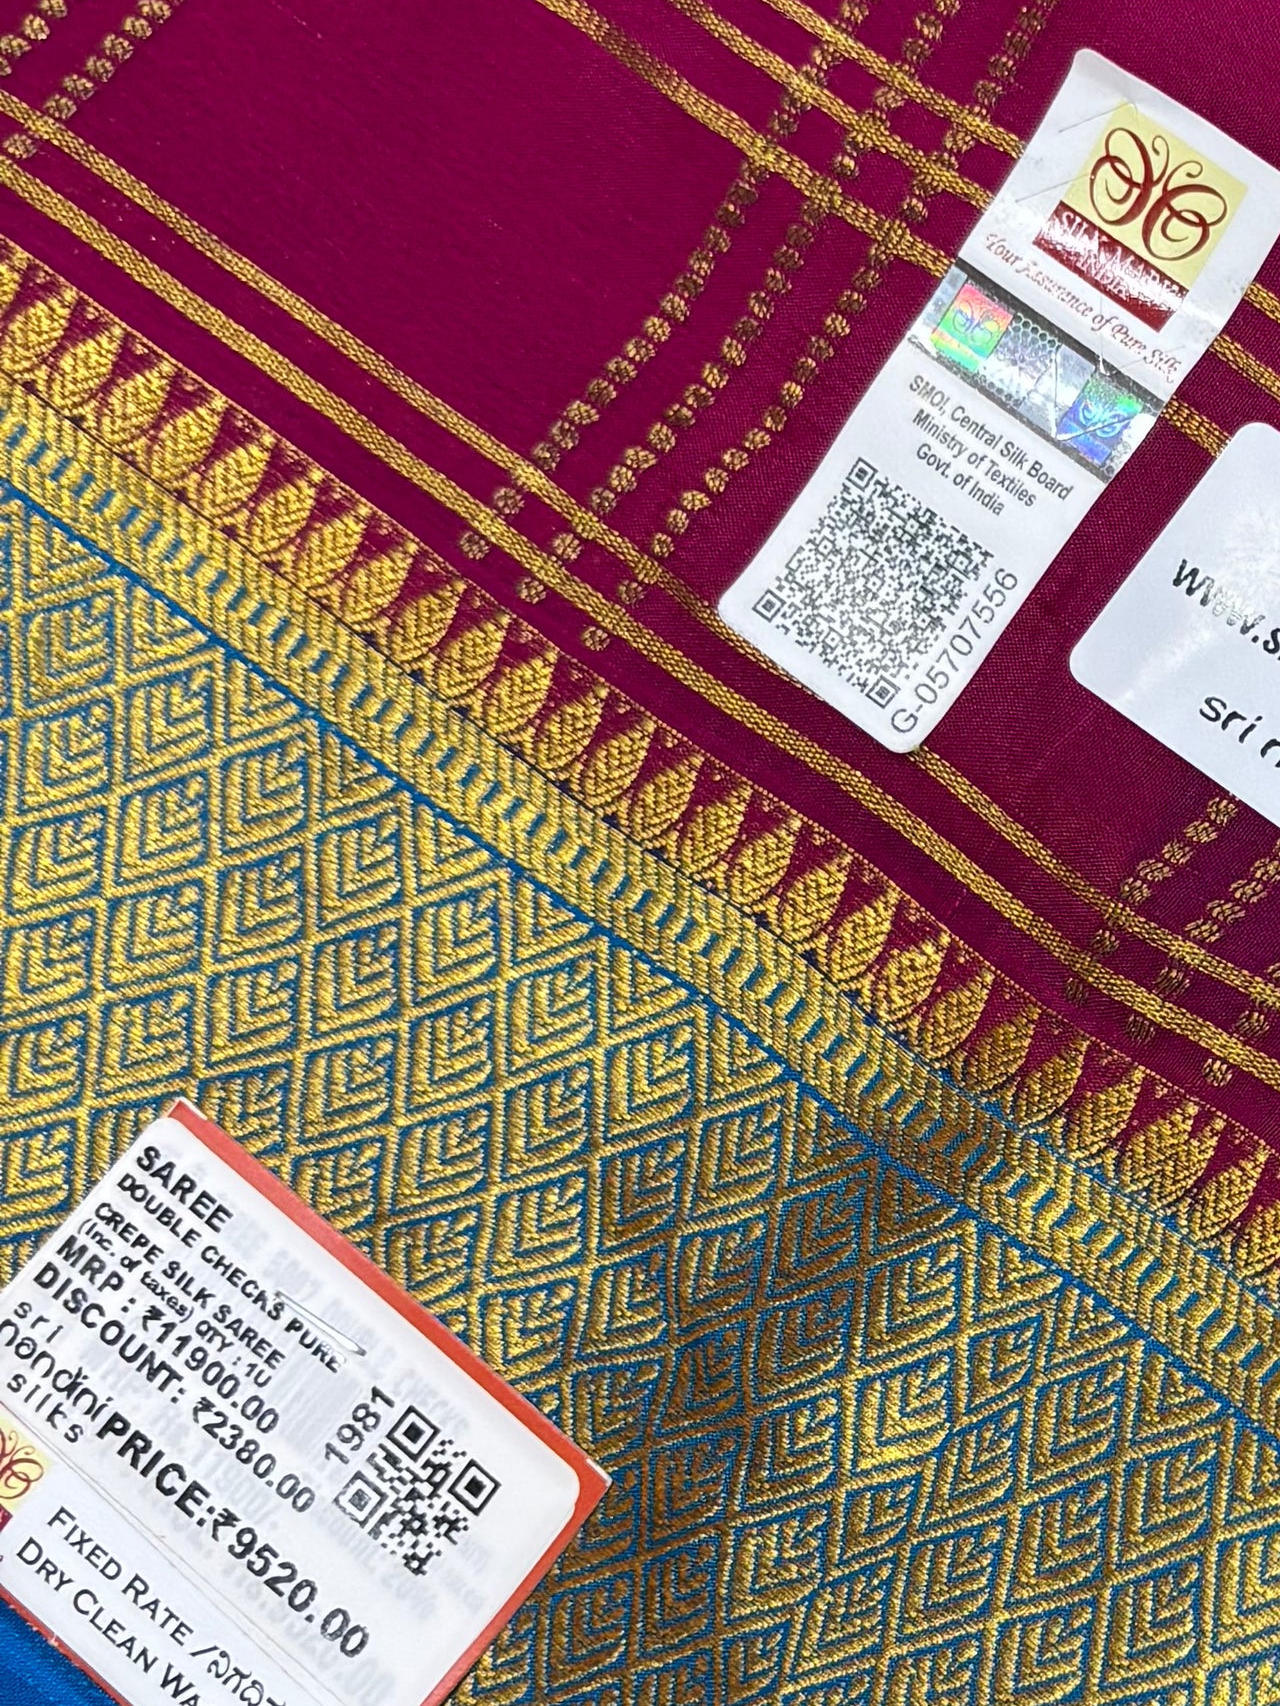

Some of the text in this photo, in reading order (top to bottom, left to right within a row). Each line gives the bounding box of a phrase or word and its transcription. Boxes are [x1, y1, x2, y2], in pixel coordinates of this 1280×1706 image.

[986, 233, 1182, 384] Your Assurance of Pure Silk
[909, 375, 1074, 501] SMOI, Central Silk Board
[912, 409, 1037, 507] Ministry of Textiles
[916, 444, 1005, 516] Govt. of India
[891, 568, 1018, 733] G-05707556
[1200, 697, 1263, 743] sri
[137, 1146, 233, 1233] SAREE
[14, 1301, 63, 1343] sri
[56, 1235, 124, 1292] MRP
[141, 1305, 279, 1434] ₹11900.00
[77, 1218, 116, 1257] (Inc.
[140, 1271, 194, 1322] taxes)
[195, 1320, 234, 1353] QTY
[244, 1363, 273, 1388] 1U
[95, 1203, 286, 1369] CREPE SILK SAREE
[117, 1173, 345, 1374] DOUBLE CHECKS PURE
[0, 1319, 114, 1422] nandini
[7, 1374, 84, 1443] silks
[33, 1262, 187, 1404] DISCOUNT:
[192, 1396, 315, 1513] ₹2380.00
[324, 1385, 396, 1465] 1981
[16, 1537, 75, 1592] DRY
[72, 1589, 159, 1674] CLEAN
[47, 1506, 194, 1646] FIXED RATE
